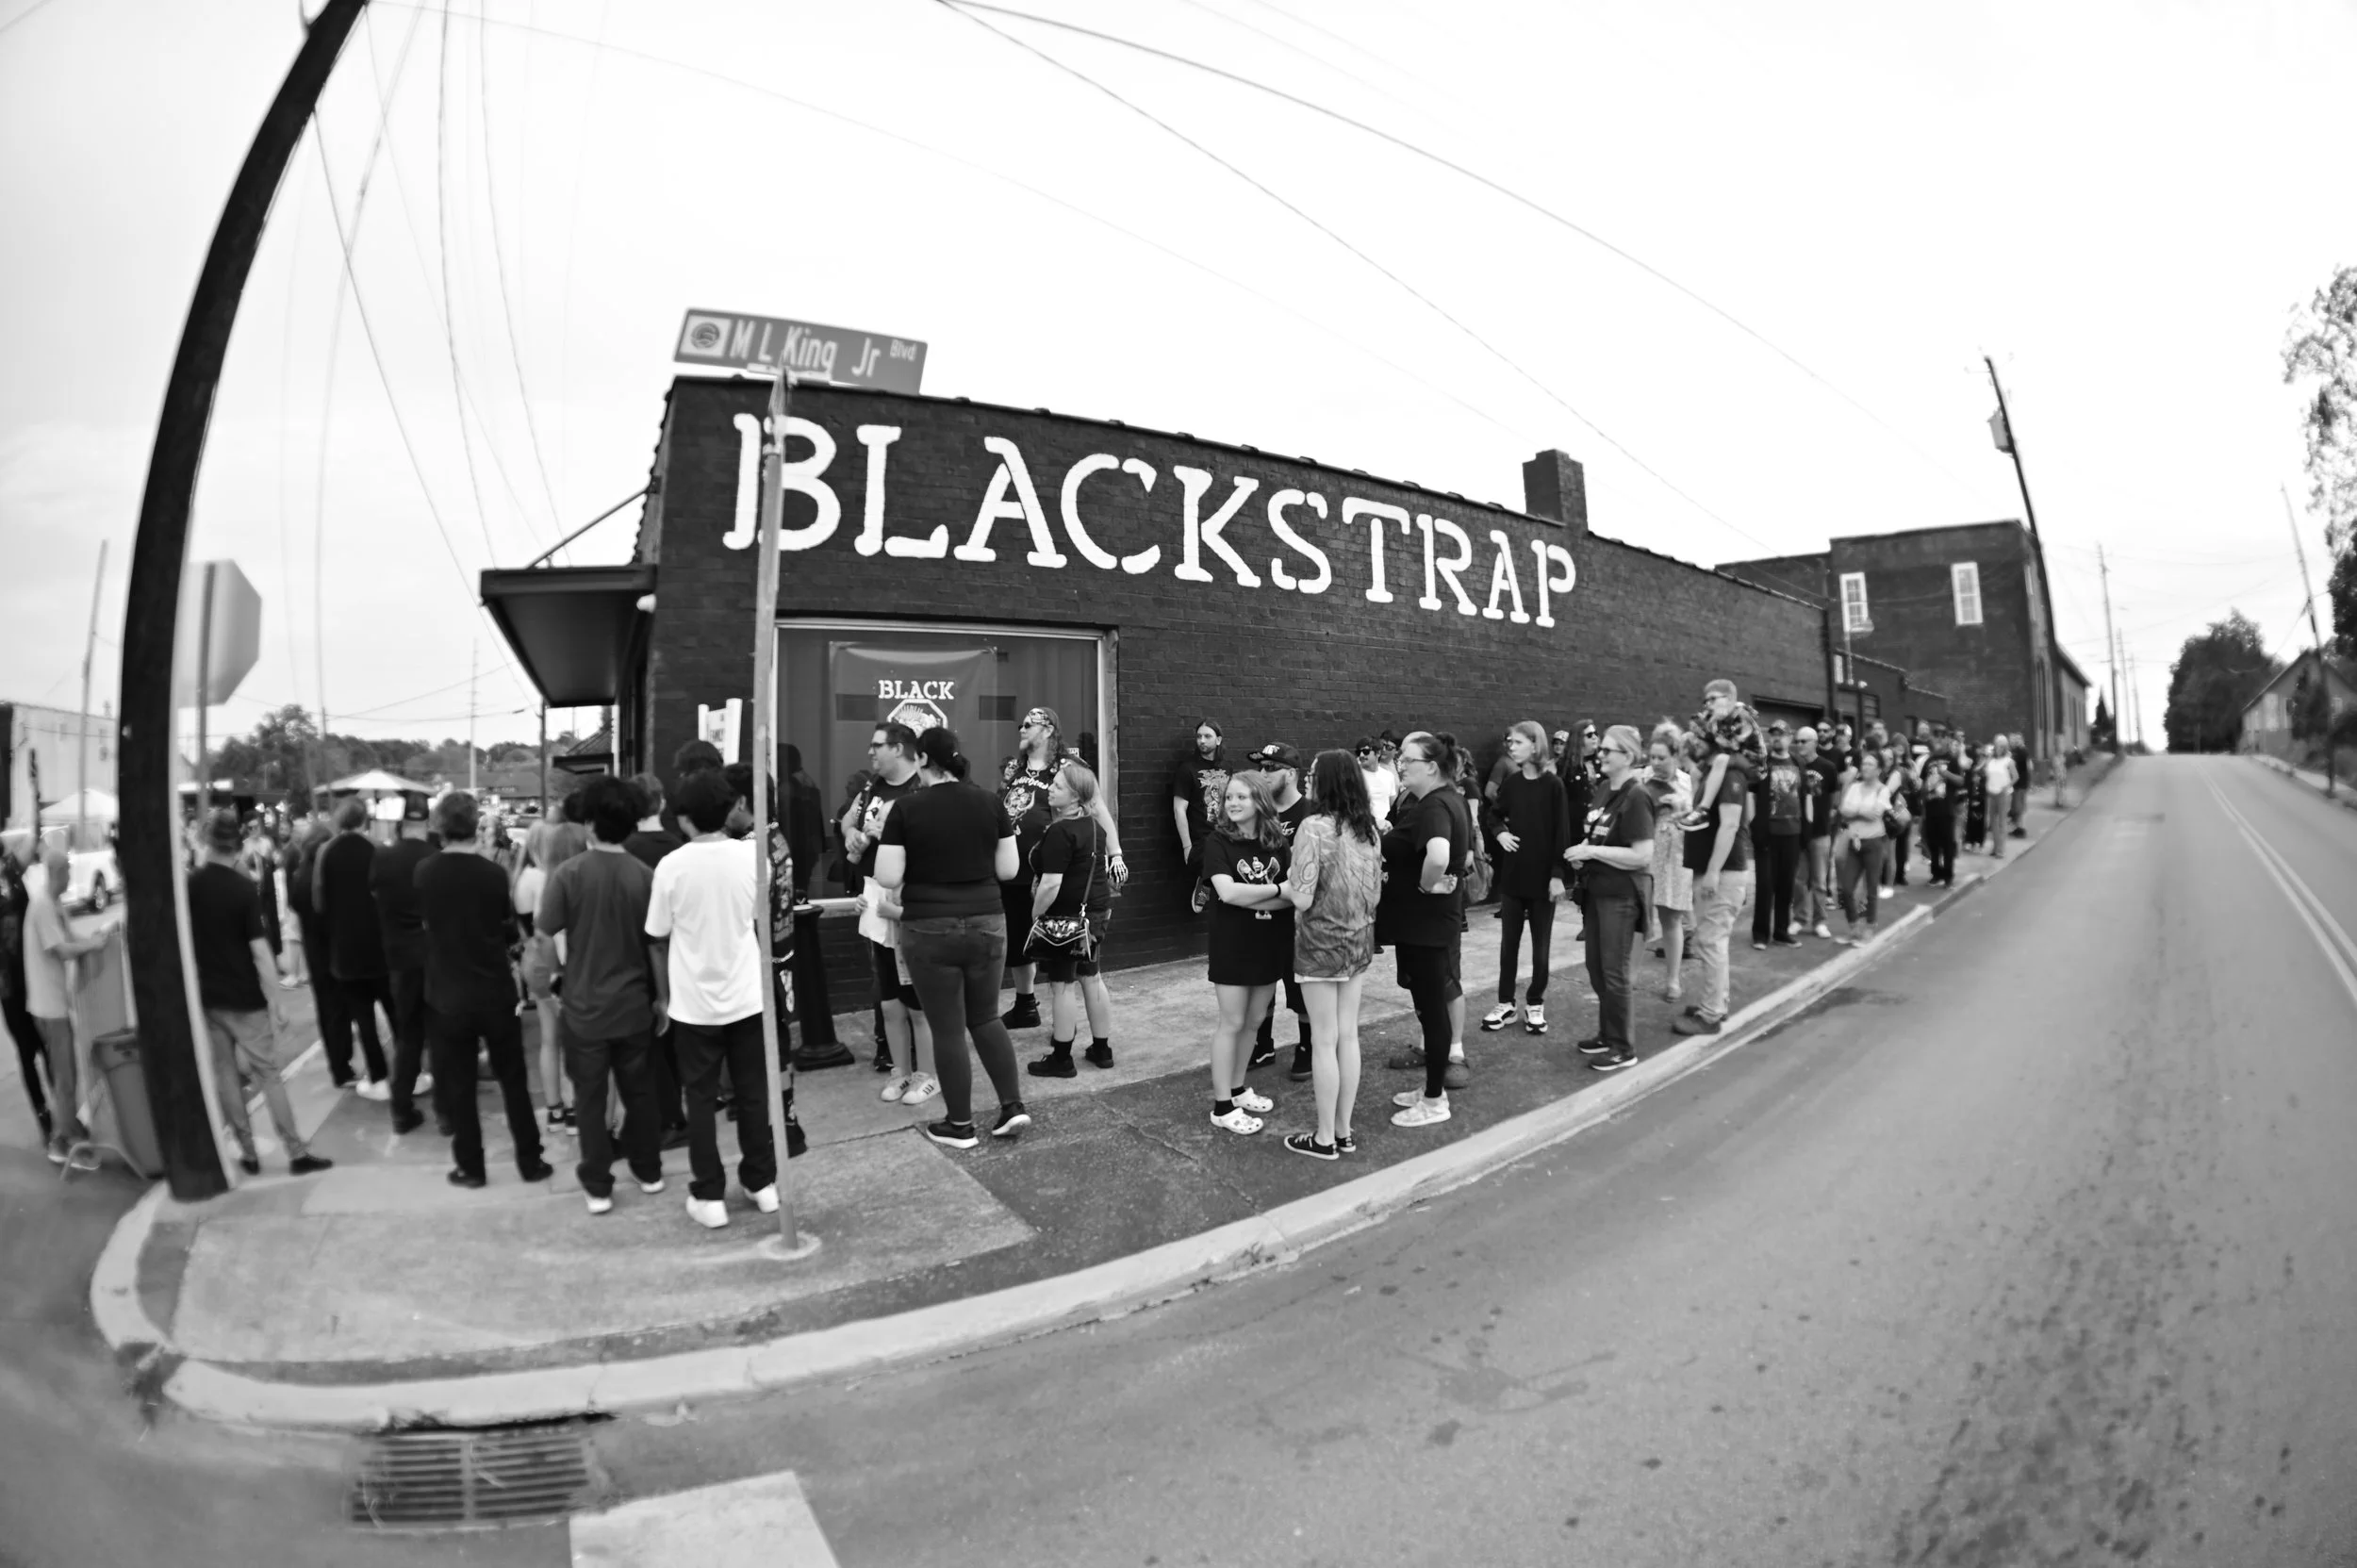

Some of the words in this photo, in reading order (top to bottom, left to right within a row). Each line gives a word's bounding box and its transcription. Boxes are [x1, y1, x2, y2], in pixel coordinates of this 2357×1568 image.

[729, 319, 756, 360] M
[758, 322, 773, 363] L
[782, 325, 838, 375] King
[850, 337, 881, 378] Jr
[890, 338, 917, 362] Blvd
[722, 412, 1576, 629] BLACKSTRAP
[878, 679, 955, 701] BLACK
